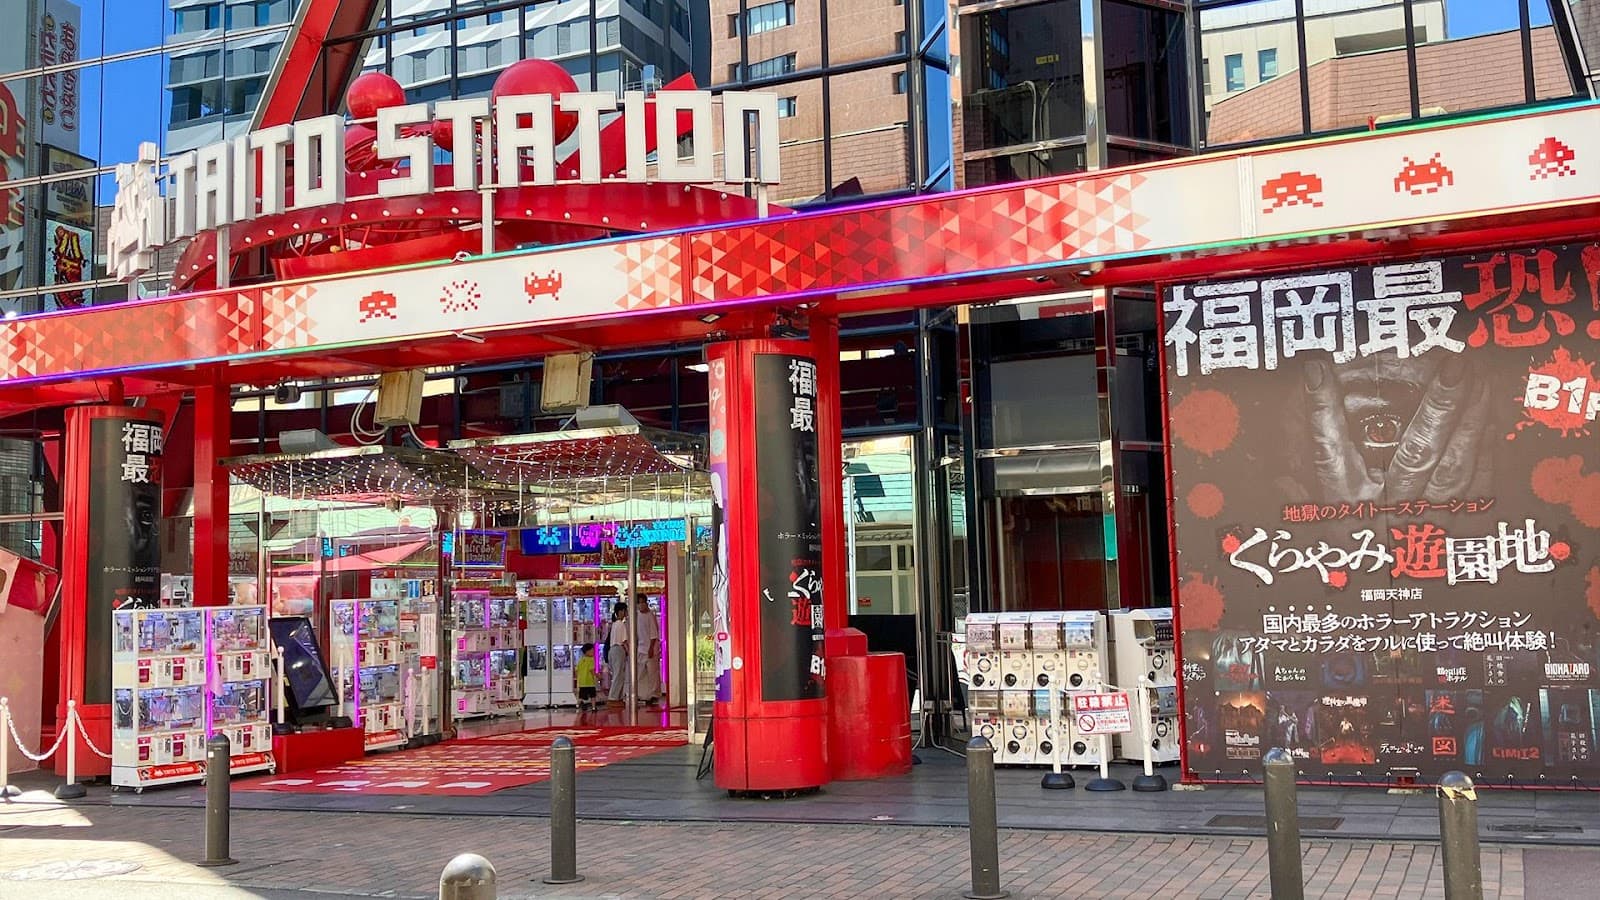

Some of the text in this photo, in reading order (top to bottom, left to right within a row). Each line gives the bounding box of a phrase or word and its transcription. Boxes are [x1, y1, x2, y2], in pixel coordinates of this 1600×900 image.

[167, 114, 346, 238] TAITO
[376, 89, 781, 198] STATION
[788, 358, 819, 398] 福
[121, 422, 164, 455] 福岡
[1283, 498, 1495, 522] 地獄のタイトーステーション
[1229, 518, 1556, 586] くらやみ遊園地
[1360, 588, 1424, 602] 福岡天神店
[1262, 612, 1533, 634] 国内最多のホラーアトラクション
[1237, 630, 1556, 654] アタマとカラダをフルに使って絶叫体験！
[1544, 663, 1590, 675] BIOHAZARD
[1077, 694, 1126, 709] 駐輪禁止
